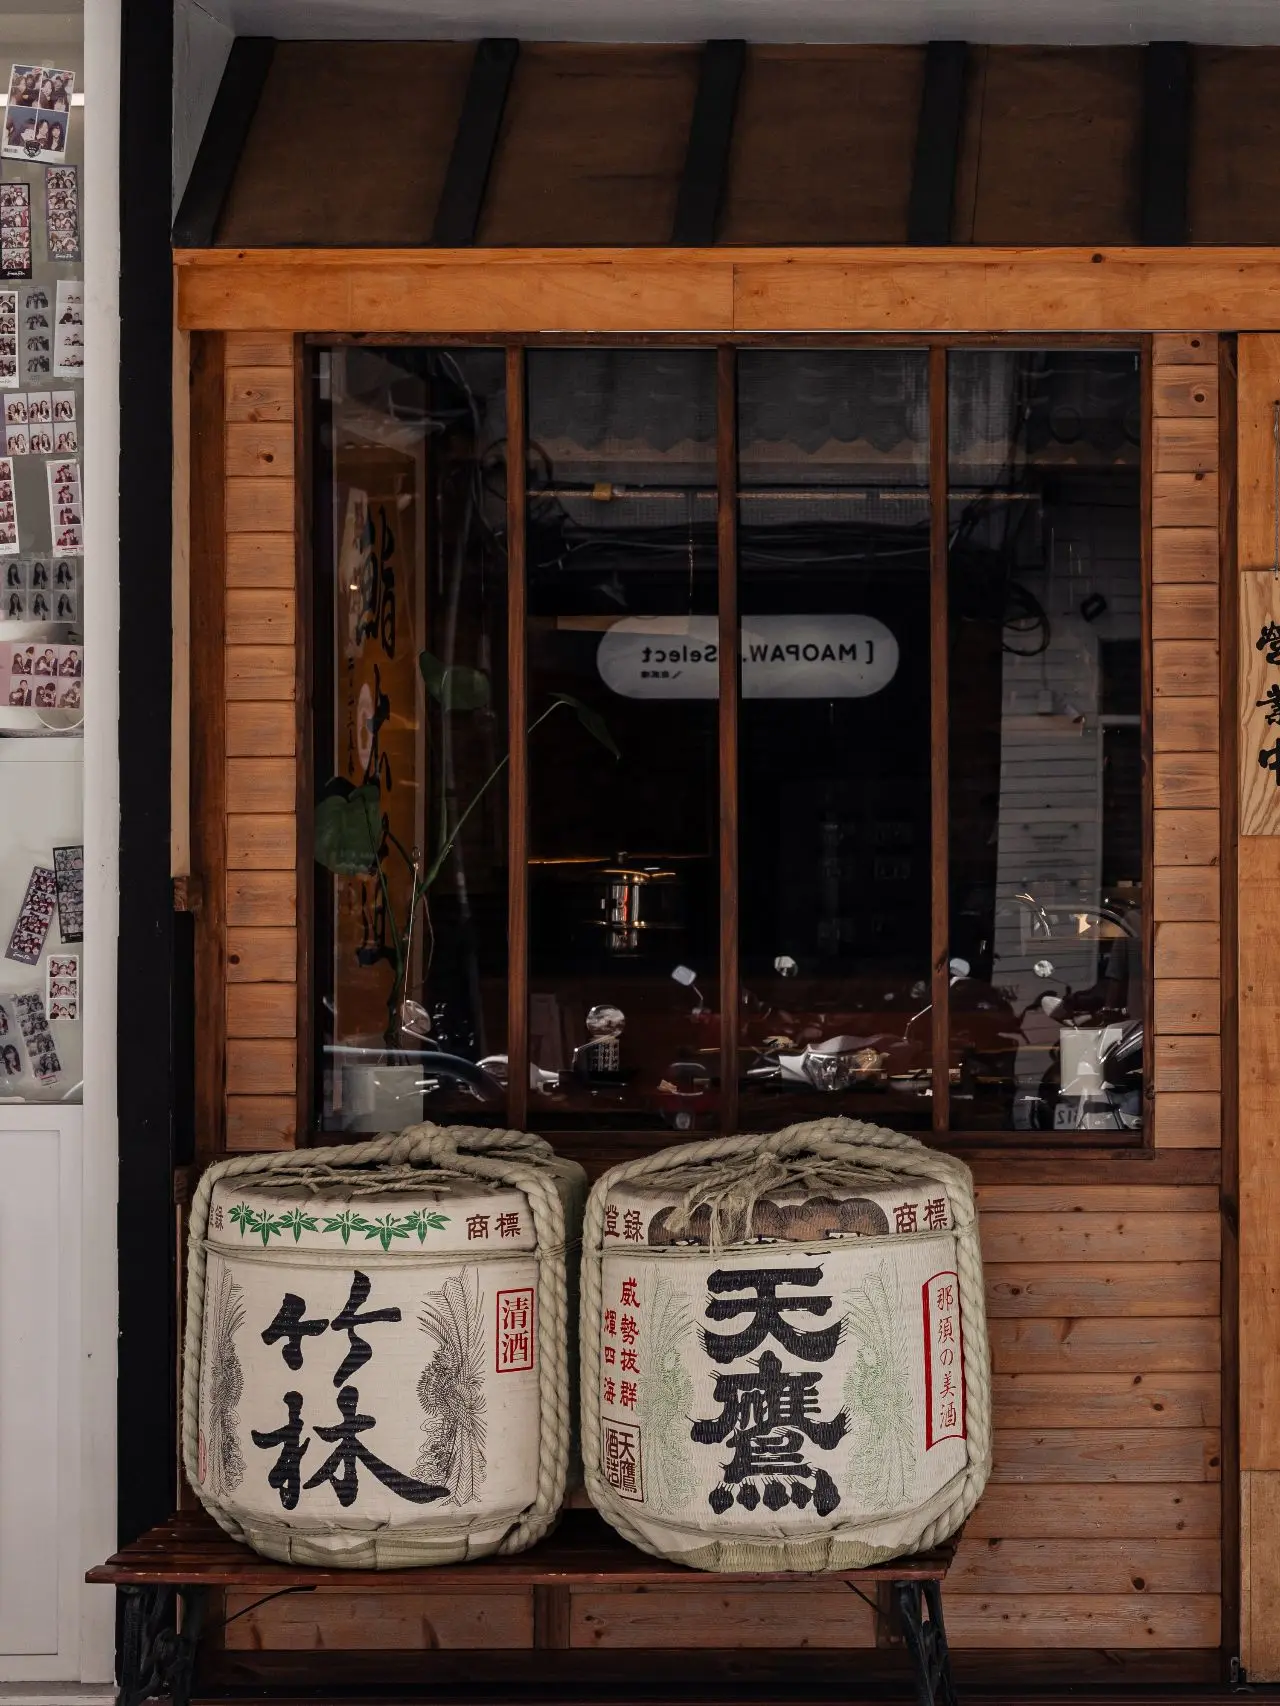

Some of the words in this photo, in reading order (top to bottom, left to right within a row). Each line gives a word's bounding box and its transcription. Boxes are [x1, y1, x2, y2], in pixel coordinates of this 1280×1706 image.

[465, 1212, 522, 1241] 商標
[604, 1204, 644, 1243] 登録
[893, 1197, 948, 1233] 商標
[501, 1297, 530, 1364] 清酒
[936, 1284, 957, 1429] 那須の美酒
[250, 1270, 451, 1512] 竹林
[685, 1263, 851, 1518] 天鷹
